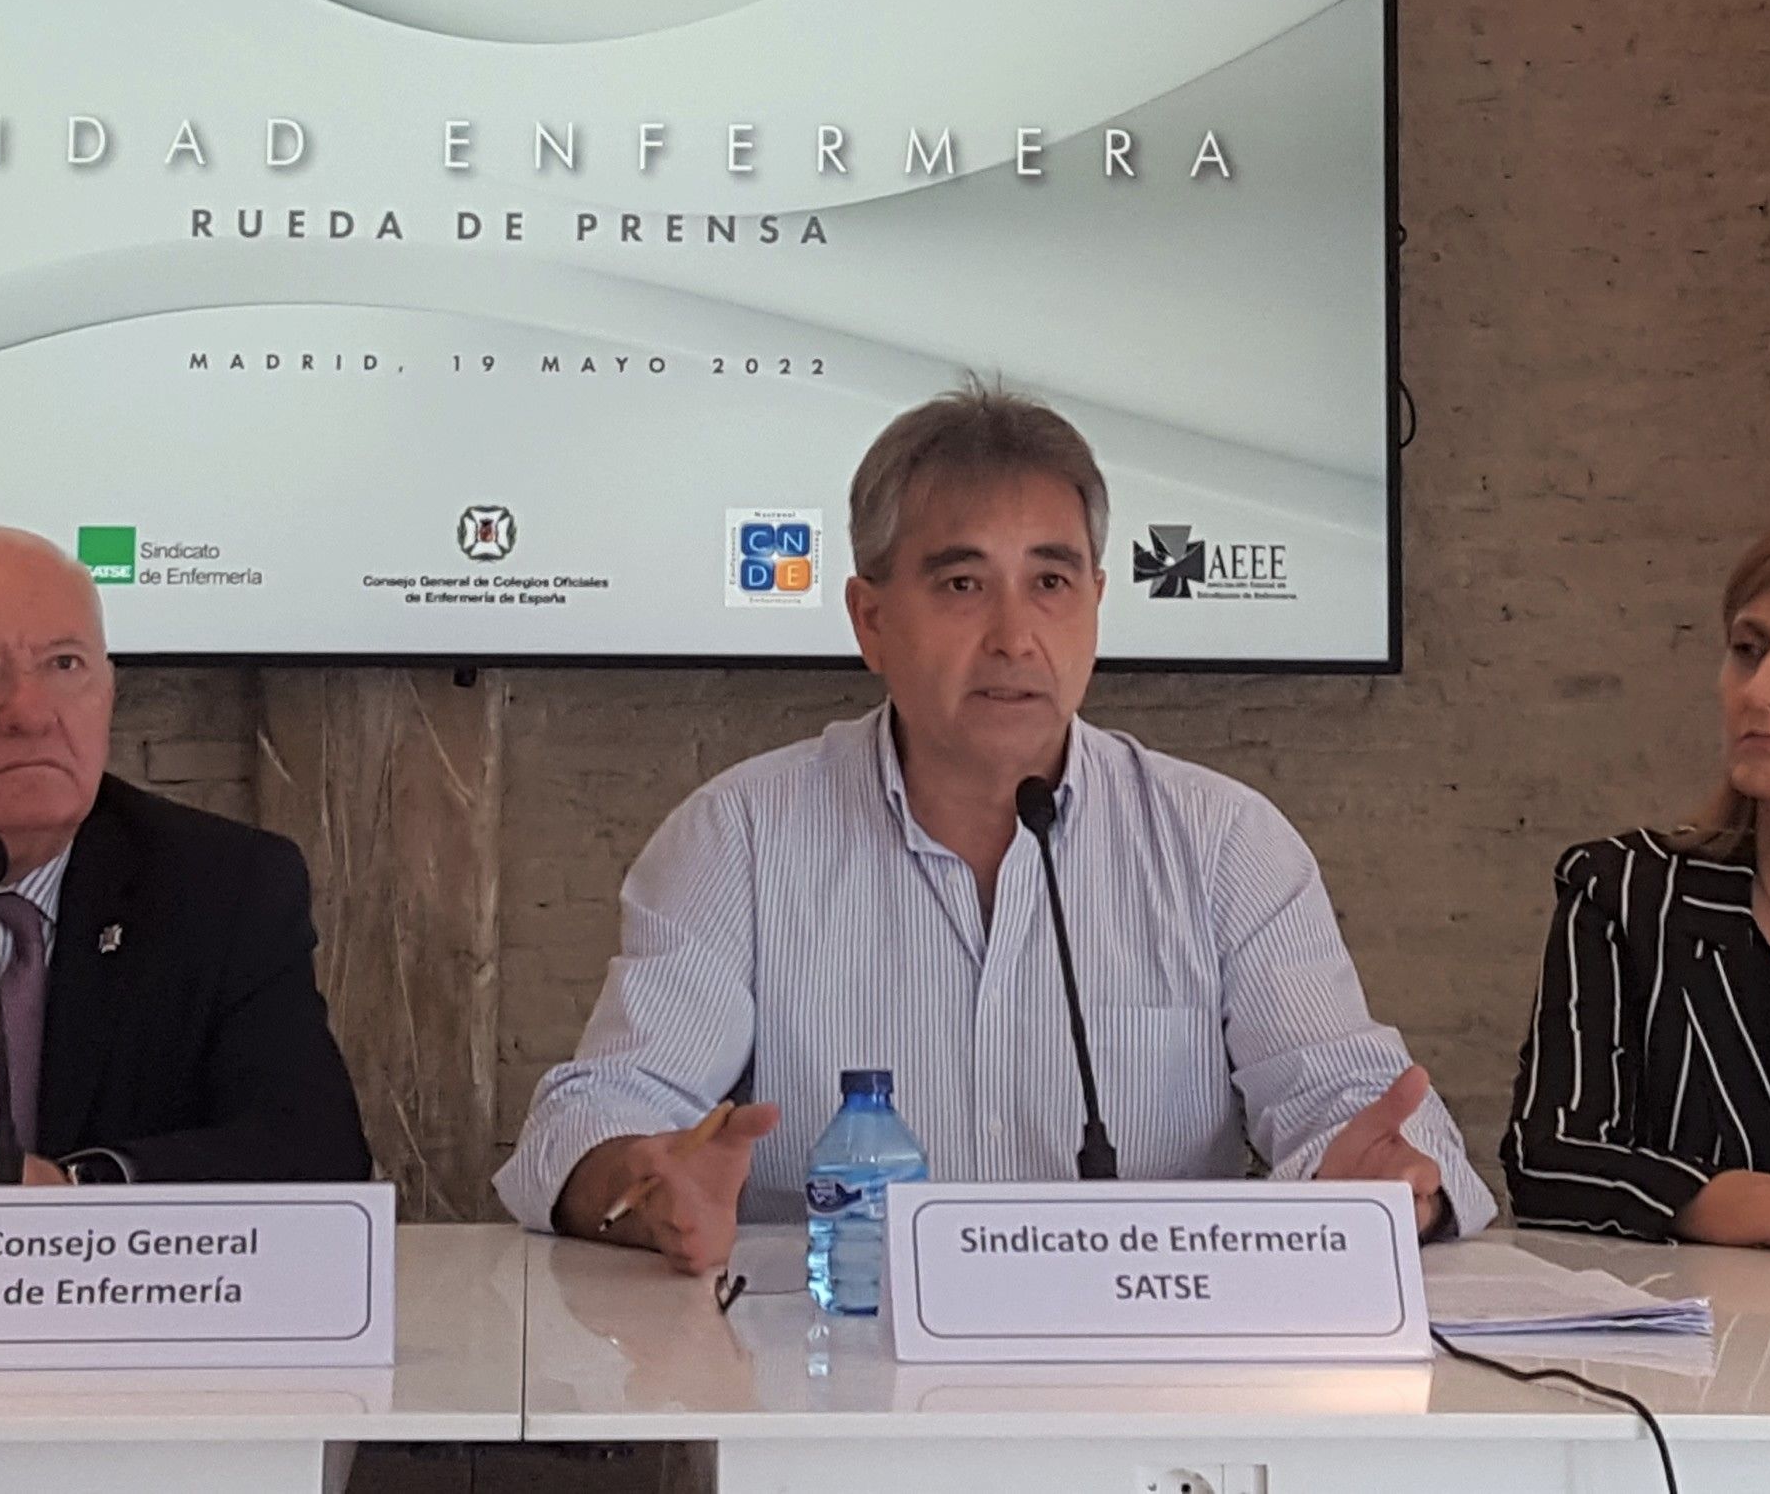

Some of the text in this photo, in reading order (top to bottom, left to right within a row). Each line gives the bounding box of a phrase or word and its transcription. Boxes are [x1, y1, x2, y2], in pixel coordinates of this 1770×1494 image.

[443, 120, 1231, 179] ENFERMERA
[190, 208, 829, 246] RUEDA DE PRENSA
[188, 352, 825, 376] MADRID, 19 MAYO 2022
[139, 541, 221, 560] Sindicato
[1207, 544, 1288, 580] AEEE
[138, 567, 263, 586] de Enfermería
[362, 575, 609, 590] Consejo General de Colegios Oficiales
[404, 590, 567, 606] de Enfermería de España
[126, 1227, 259, 1257] General
[960, 1223, 1348, 1254] Sindicato de Enfermería
[2, 1275, 243, 1306] de Enfermería
[1114, 1273, 1212, 1301] SATSE
